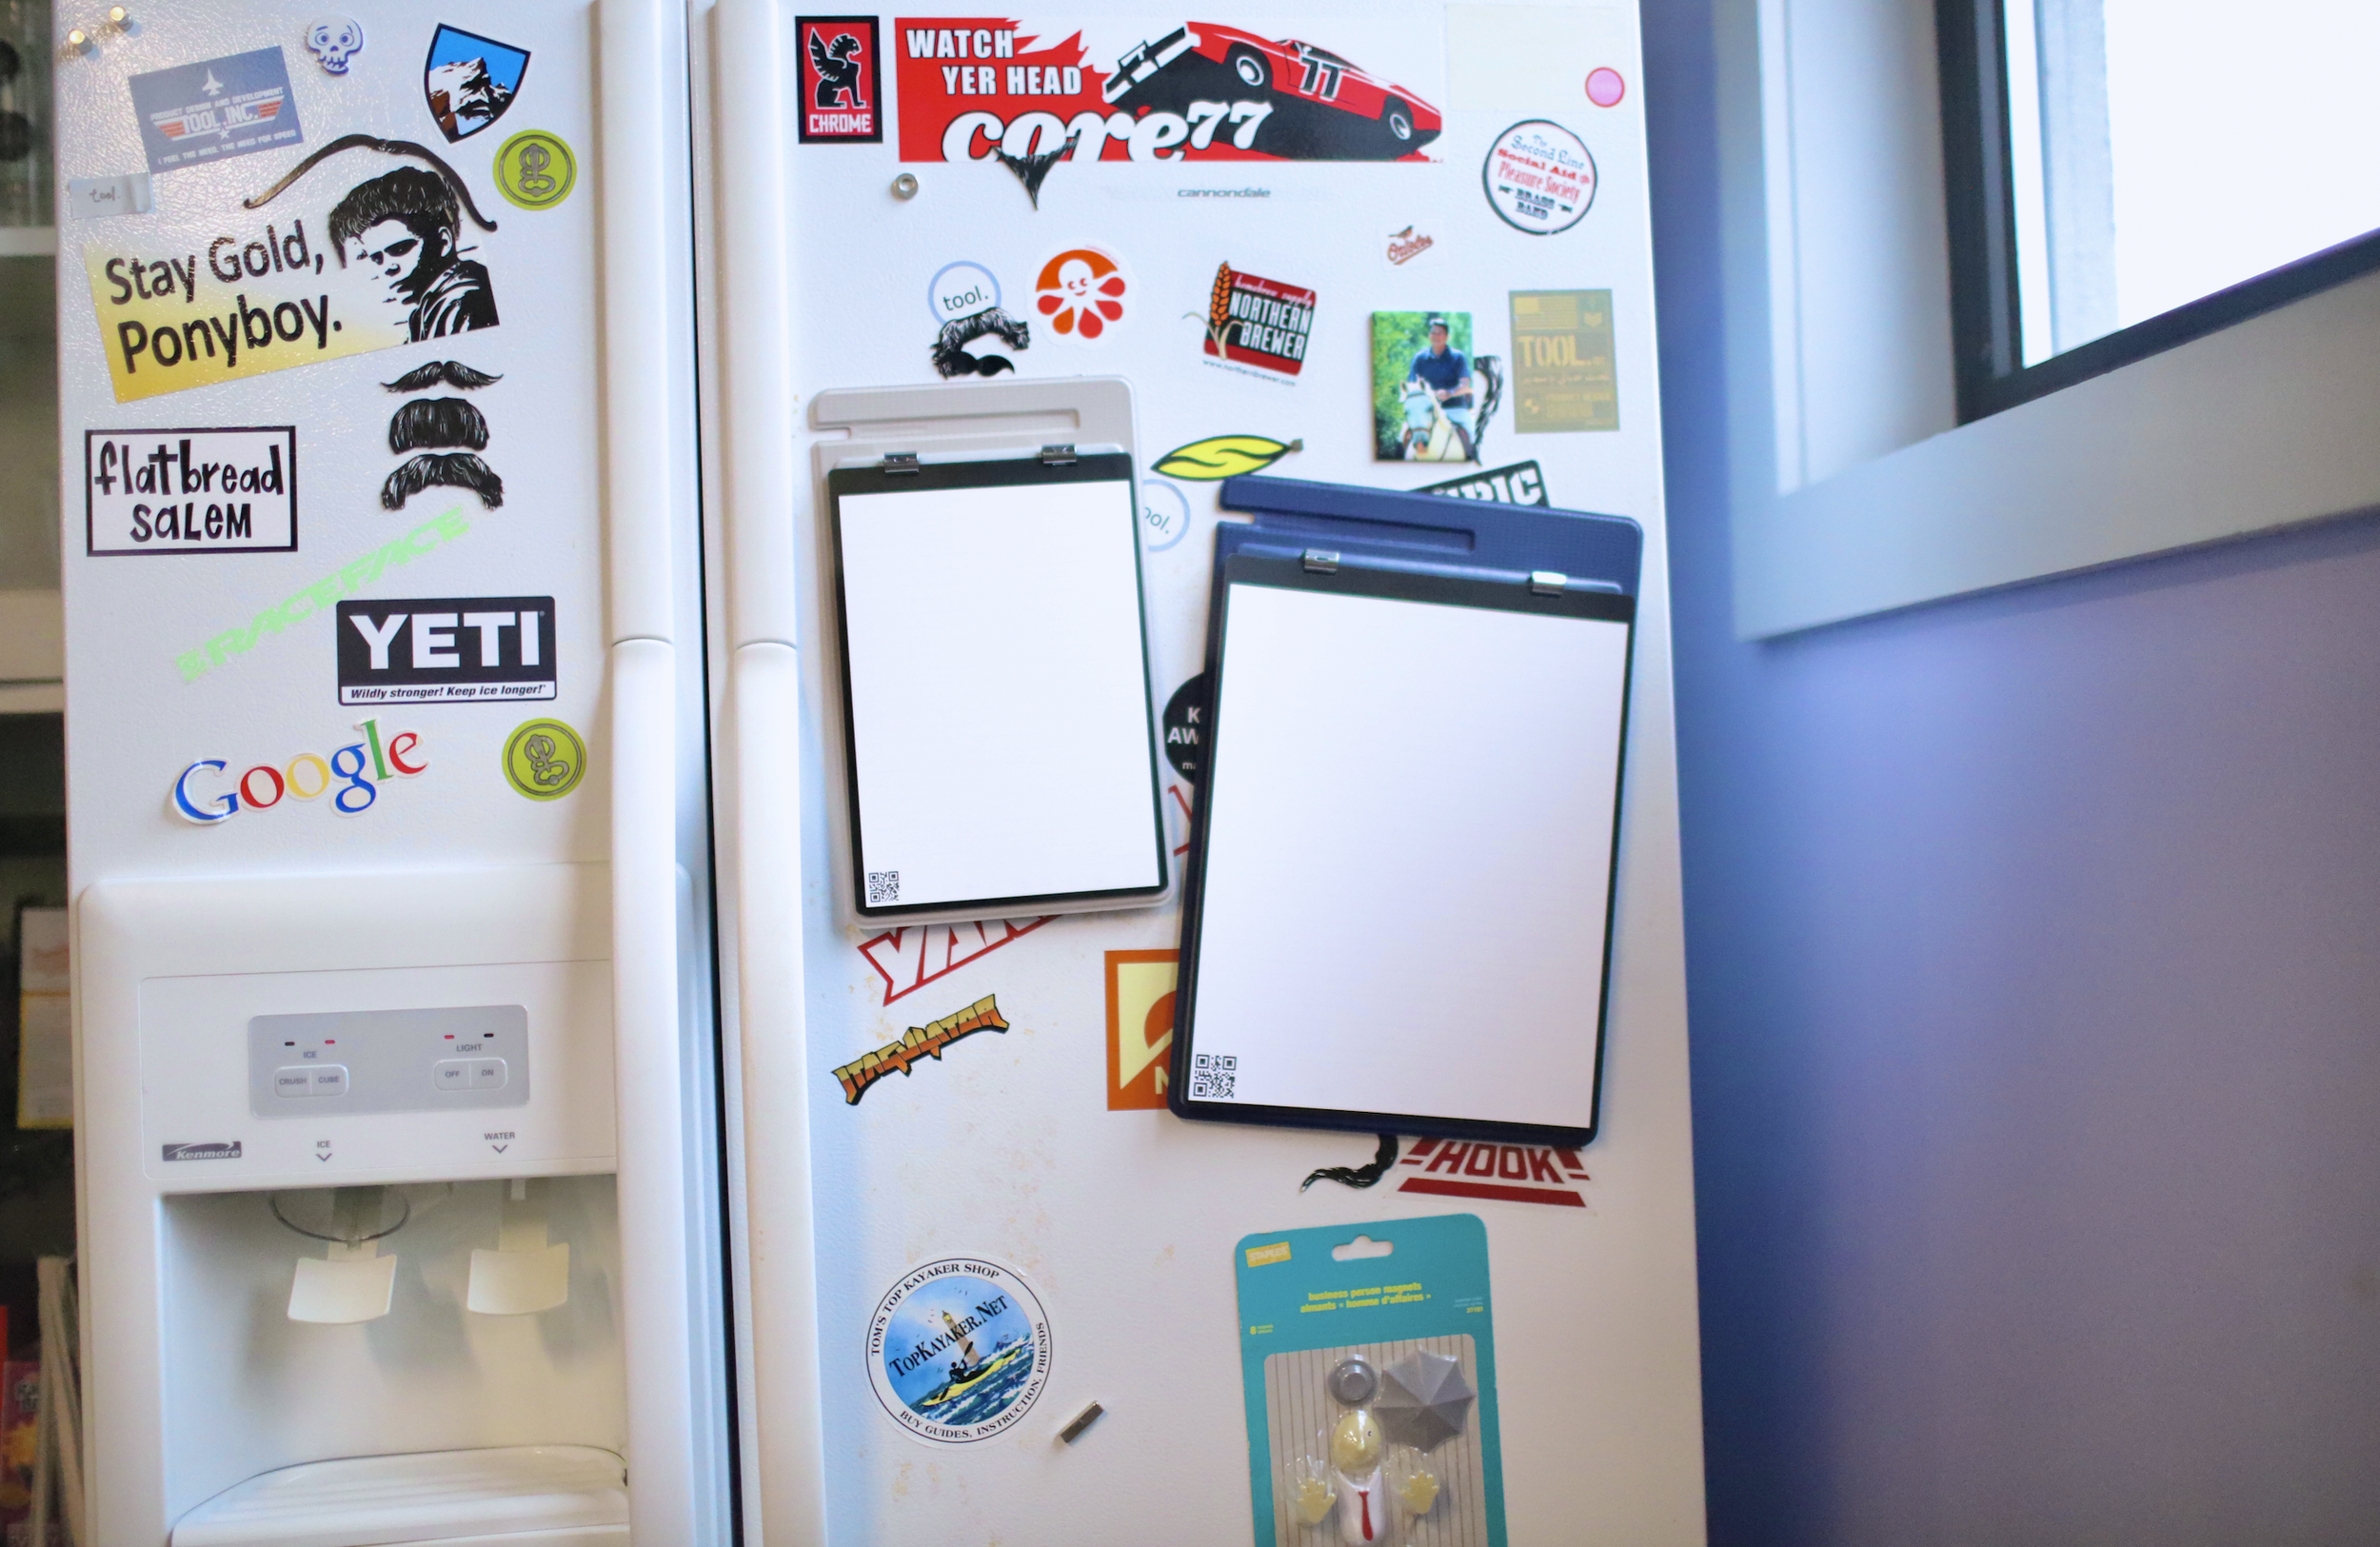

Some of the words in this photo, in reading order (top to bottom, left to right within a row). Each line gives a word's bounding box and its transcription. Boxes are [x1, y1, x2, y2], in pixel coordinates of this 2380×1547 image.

[905, 28, 1014, 59] WATCH
[941, 64, 998, 95] YER
[1005, 64, 1082, 95] HEAD
[149, 109, 183, 121] PRODUCT
[186, 102, 211, 113] DESIGN
[214, 97, 230, 107] AND
[232, 87, 284, 104] DEVELOPMENT
[182, 109, 221, 135] TOOL
[809, 113, 872, 133] CHROME
[163, 154, 181, 164] FEEL
[182, 150, 196, 159] THE
[222, 143, 235, 151] THE
[237, 138, 256, 148] NEED
[258, 134, 272, 143] FOR
[273, 129, 297, 140] SPEED
[1497, 148, 1546, 171] Social
[1549, 165, 1577, 181] Aid
[1177, 188, 1272, 199] cannondale
[1497, 160, 1544, 190] Pleasure
[1544, 175, 1581, 204] Society
[105, 254, 196, 306] Stay
[208, 219, 325, 284] Gold,
[942, 285, 990, 311] tool.
[1229, 290, 1313, 335] NORTHERN
[117, 294, 343, 374] Ponyboy.
[1239, 321, 1306, 361] BREWER
[94, 439, 285, 496] flatbread
[348, 610, 540, 670] YETI
[350, 688, 387, 700] Wildly
[389, 687, 444, 698] stronger!
[446, 685, 476, 698] Keep
[479, 684, 498, 695] ice
[501, 684, 544, 697] longer!
[175, 719, 428, 821] Google
[456, 1043, 483, 1053] LIGHT
[279, 1077, 307, 1085] CRUSH
[318, 1076, 341, 1084] CUBE
[445, 1069, 461, 1079] OFF
[481, 1068, 495, 1077] ON
[484, 1132, 516, 1140] WATER
[176, 1149, 241, 1160] Kenmore
[1248, 1245, 1289, 1261] STAPLES
[1299, 1302, 1337, 1313] aimants
[1345, 1298, 1380, 1308] homme
[1381, 1293, 1425, 1305] d'affaires
[1308, 1291, 1349, 1301] business
[1350, 1287, 1382, 1299] person
[1383, 1282, 1423, 1295] magnets
[871, 1316, 886, 1356] TOM'S
[883, 1289, 902, 1314] TOP
[902, 1263, 960, 1292] KAYAKER
[963, 1263, 1000, 1279] SHOP
[900, 1410, 922, 1428] BUY
[924, 1424, 973, 1438] GUIDES,
[977, 1378, 1042, 1436] INSTRUCTION,
[1037, 1321, 1048, 1374] FRIENDS
